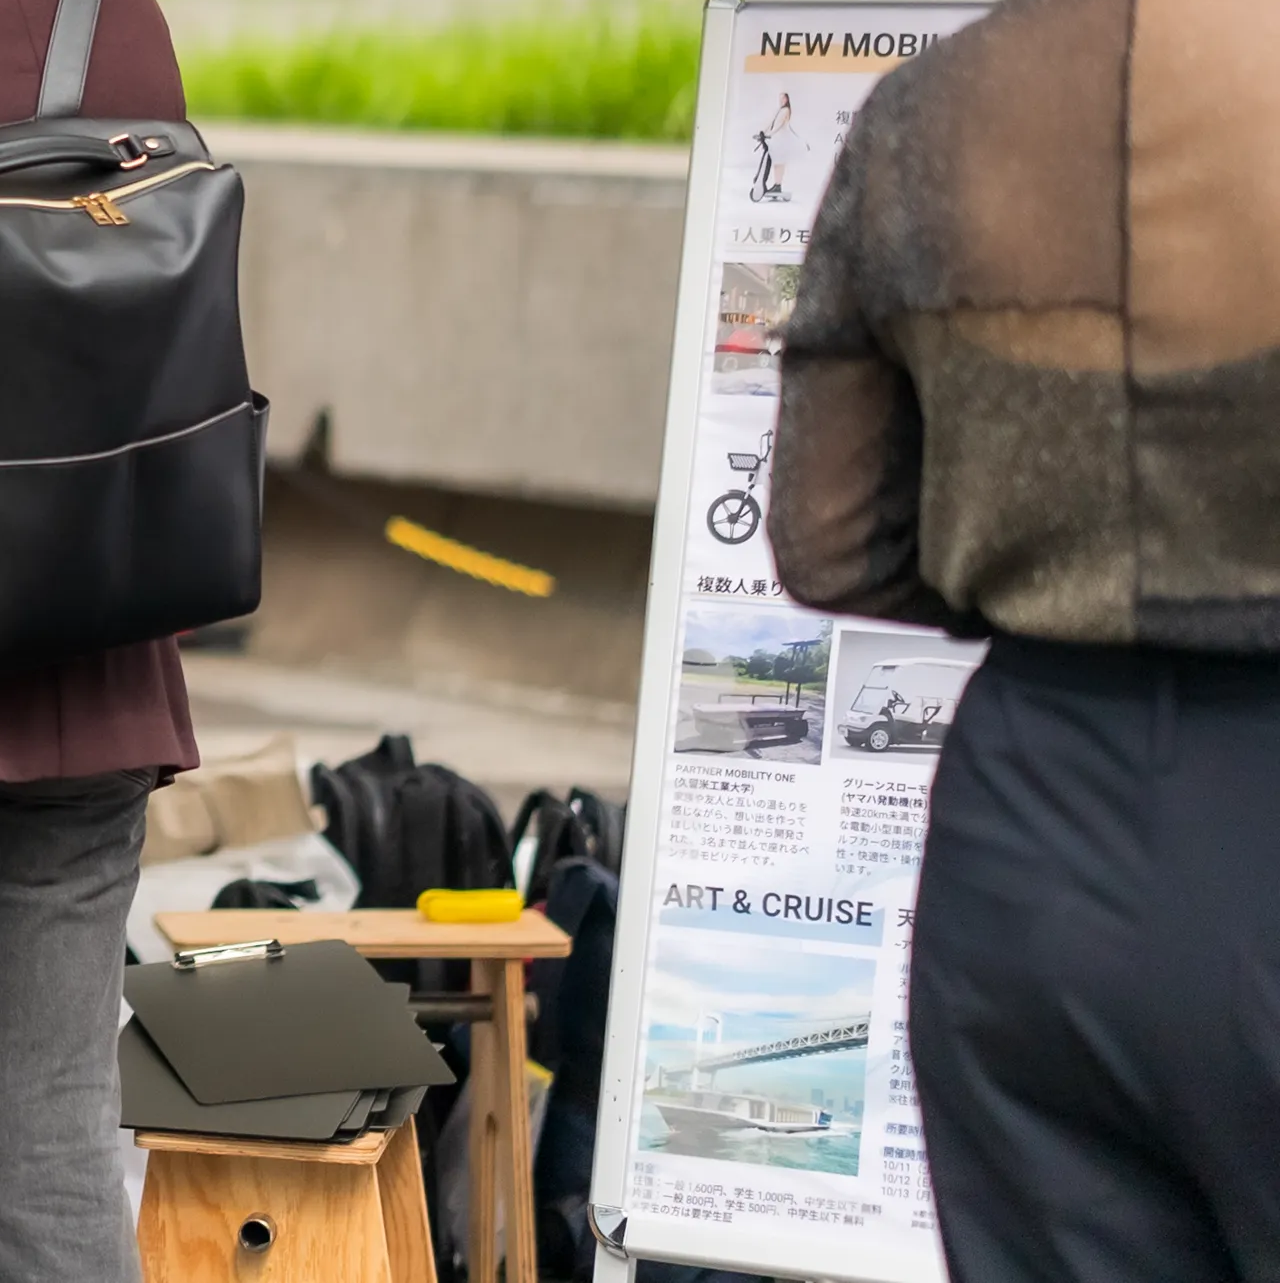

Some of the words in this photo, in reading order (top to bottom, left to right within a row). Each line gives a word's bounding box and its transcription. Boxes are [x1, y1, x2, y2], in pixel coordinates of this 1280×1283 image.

[760, 32, 832, 56] NEW
[696, 575, 784, 596] 複数人乗り
[675, 764, 722, 777] PARTNER
[724, 768, 773, 782] MOBILITY
[774, 772, 796, 784] ONE
[663, 883, 724, 911] ART
[732, 889, 752, 915] &
[762, 891, 874, 927] CRUISE
